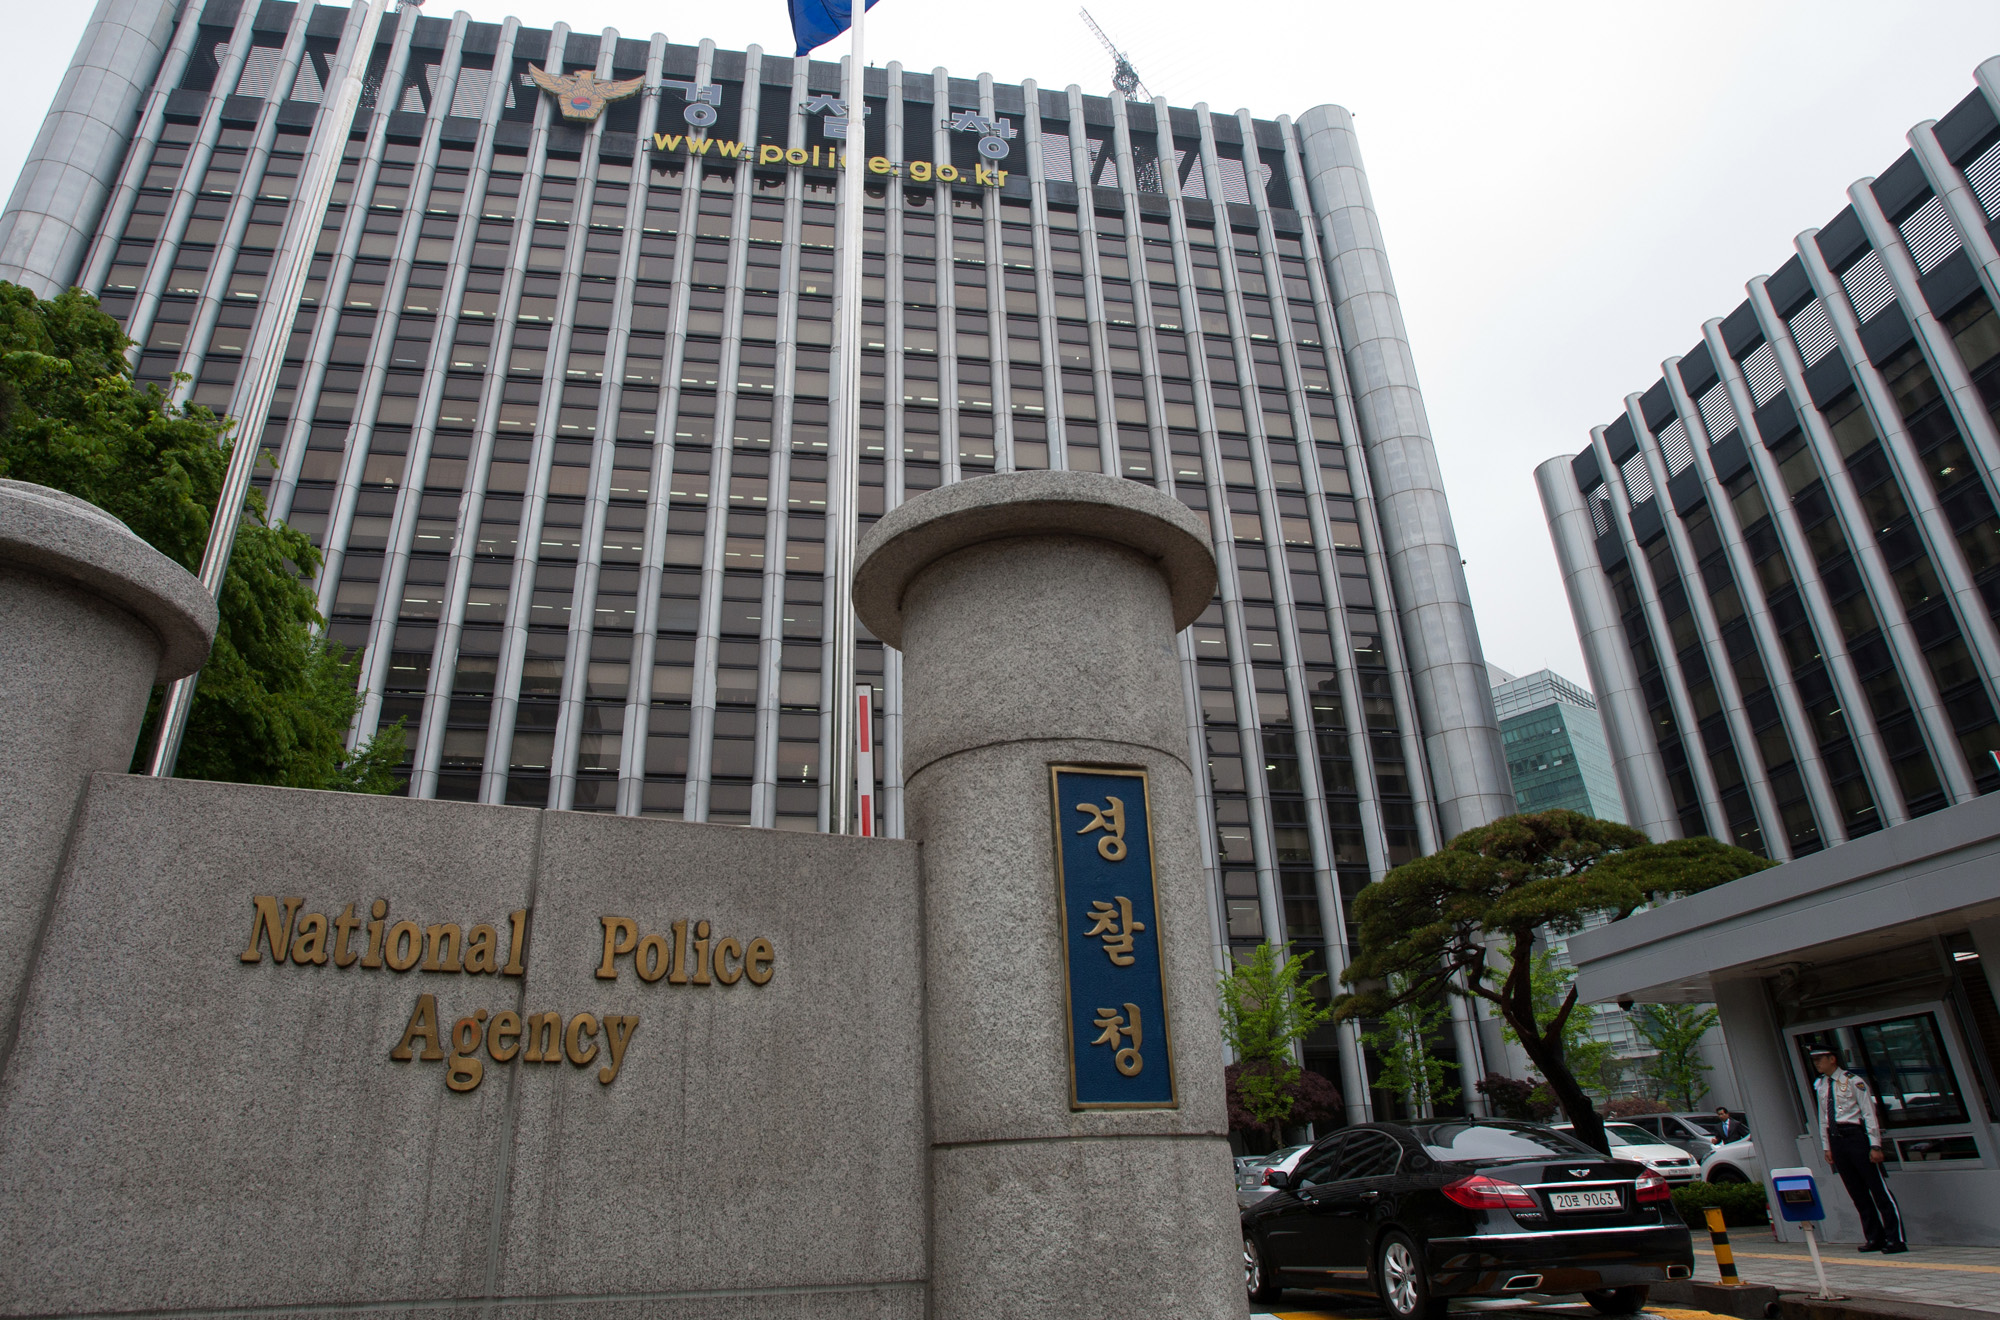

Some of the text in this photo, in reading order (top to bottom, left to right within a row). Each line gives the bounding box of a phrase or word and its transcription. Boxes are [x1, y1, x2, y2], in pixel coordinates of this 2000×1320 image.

[653, 132, 1009, 187] www.polie.go.kr
[240, 896, 776, 985] National Police
[1076, 796, 1145, 1077] 경찰청
[391, 993, 641, 1092] Agency
[1583, 1192, 1614, 1206] 9063
